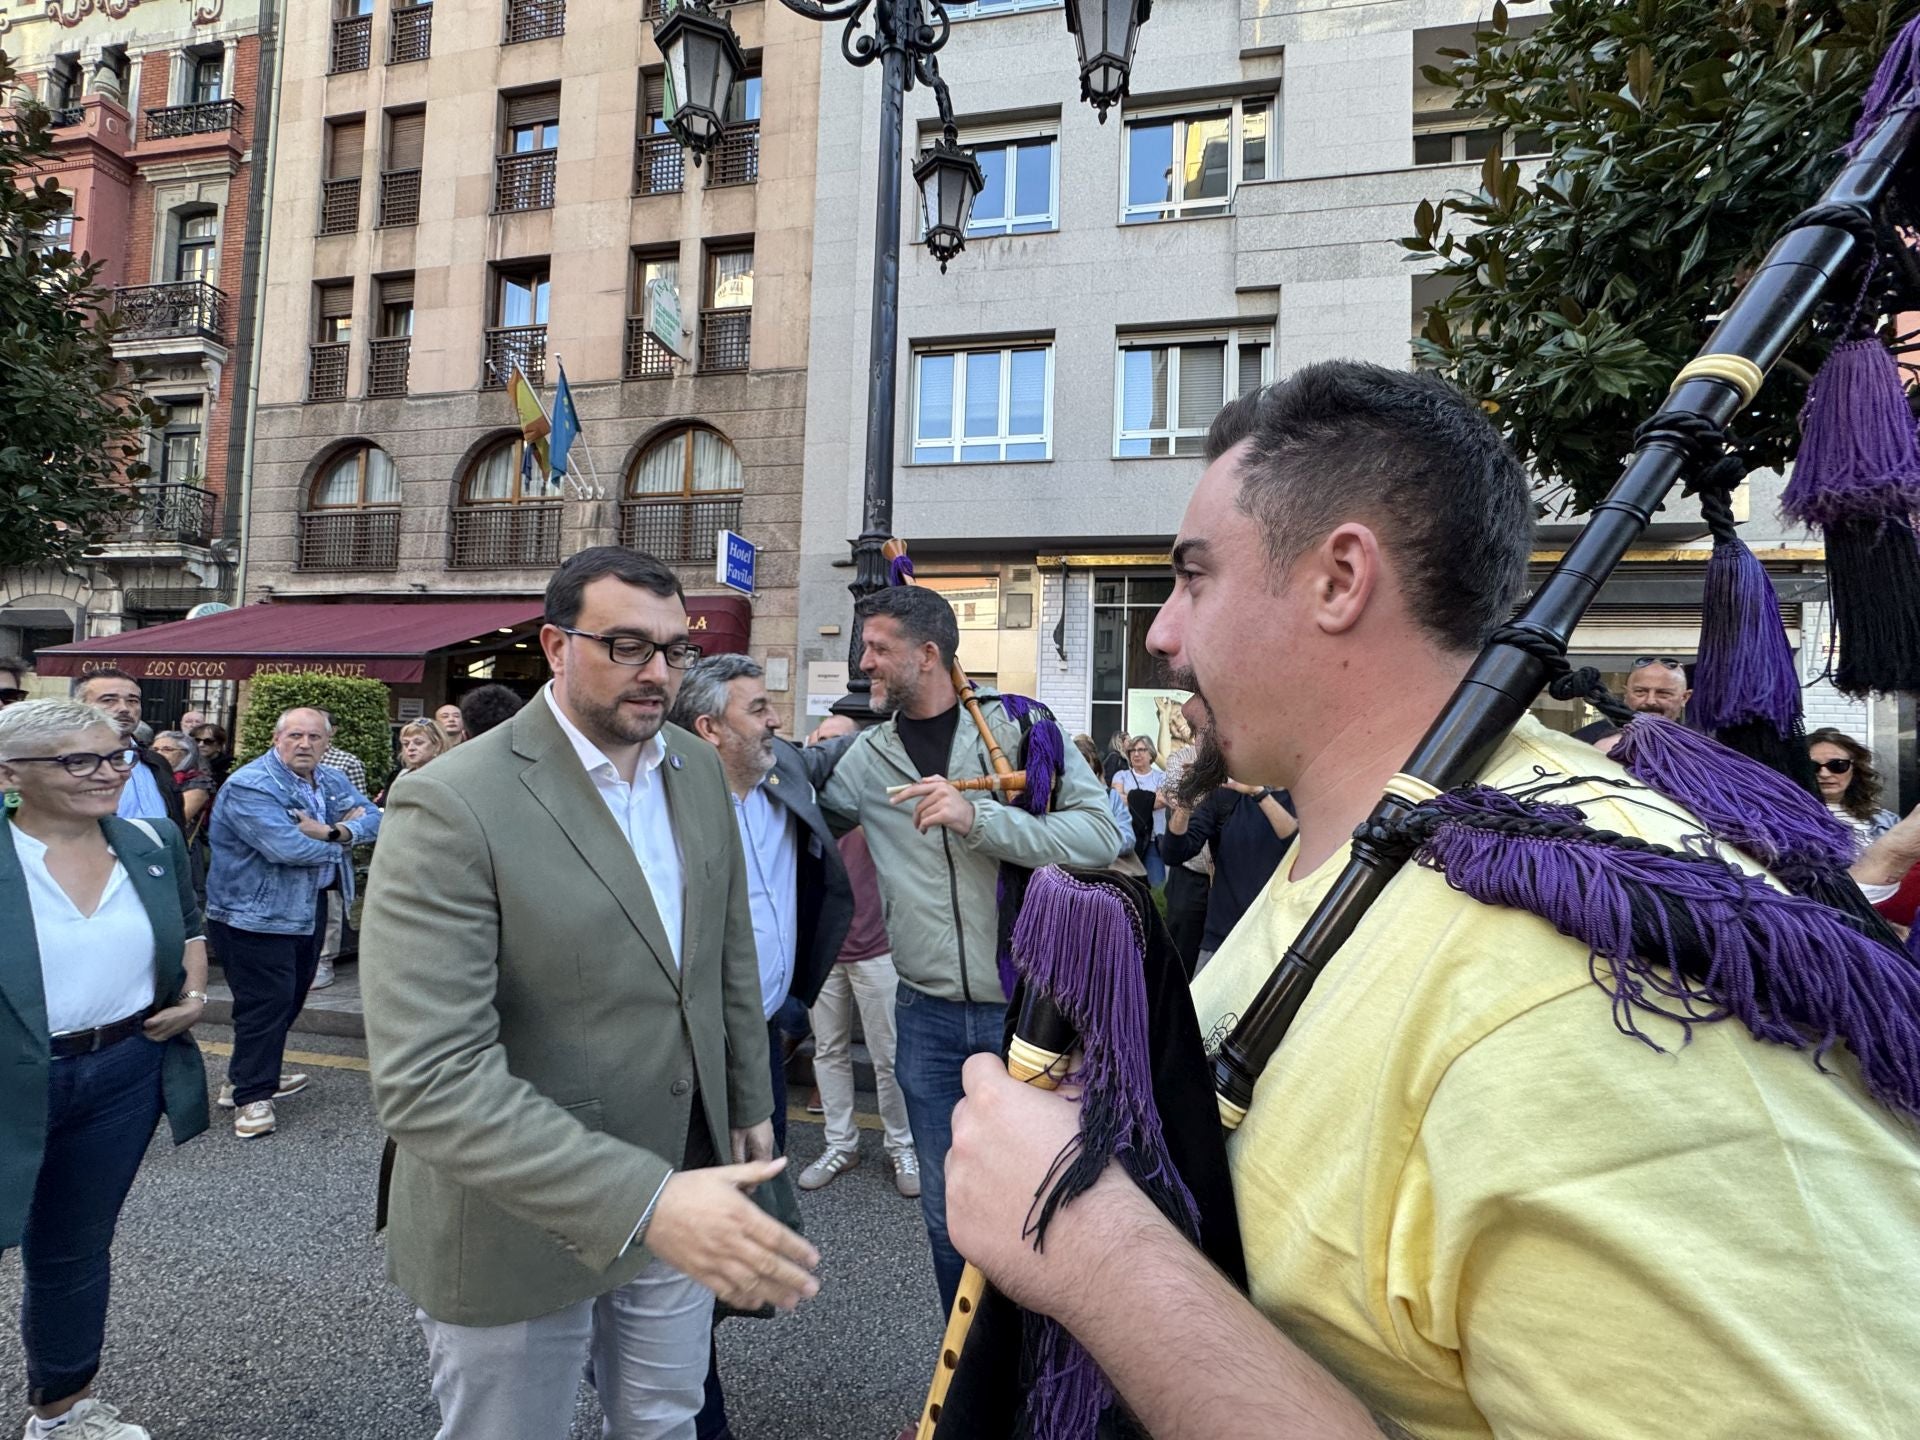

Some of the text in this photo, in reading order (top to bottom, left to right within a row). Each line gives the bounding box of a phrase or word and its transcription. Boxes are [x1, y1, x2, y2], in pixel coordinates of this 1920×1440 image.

[729, 542, 752, 564] Hotel
[727, 563, 753, 585] Favila
[82, 658, 367, 677] CAFÉ LOS OSCOS RESTAURANTE
